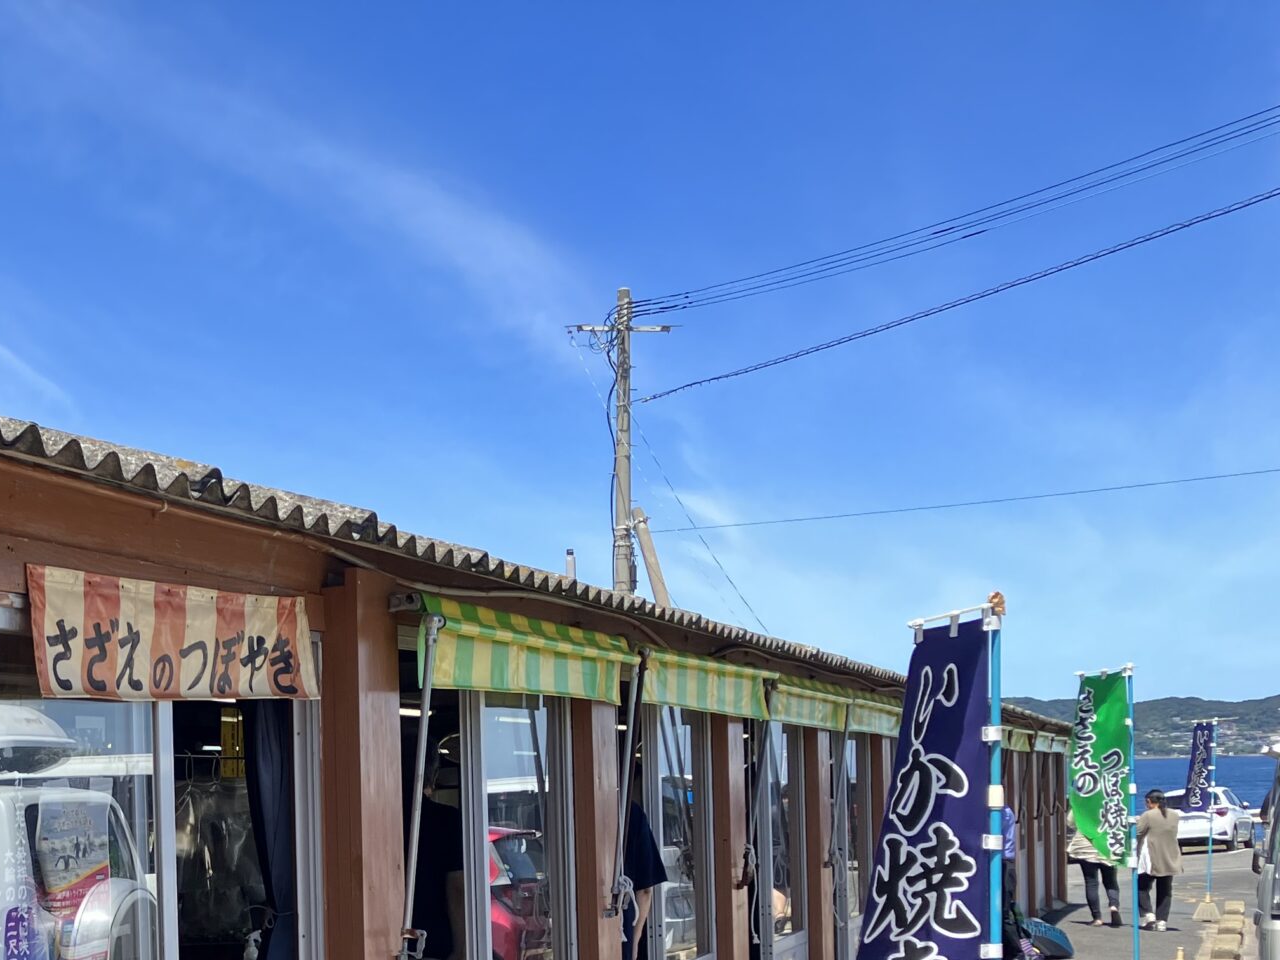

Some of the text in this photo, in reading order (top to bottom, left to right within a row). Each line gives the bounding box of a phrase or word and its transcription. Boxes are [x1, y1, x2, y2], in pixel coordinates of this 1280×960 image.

[46, 618, 298, 695] さざえのつぼやき
[1072, 687, 1101, 797] さざえの
[1190, 729, 1211, 808] いか焼き
[1097, 748, 1130, 858] つぼ焼き
